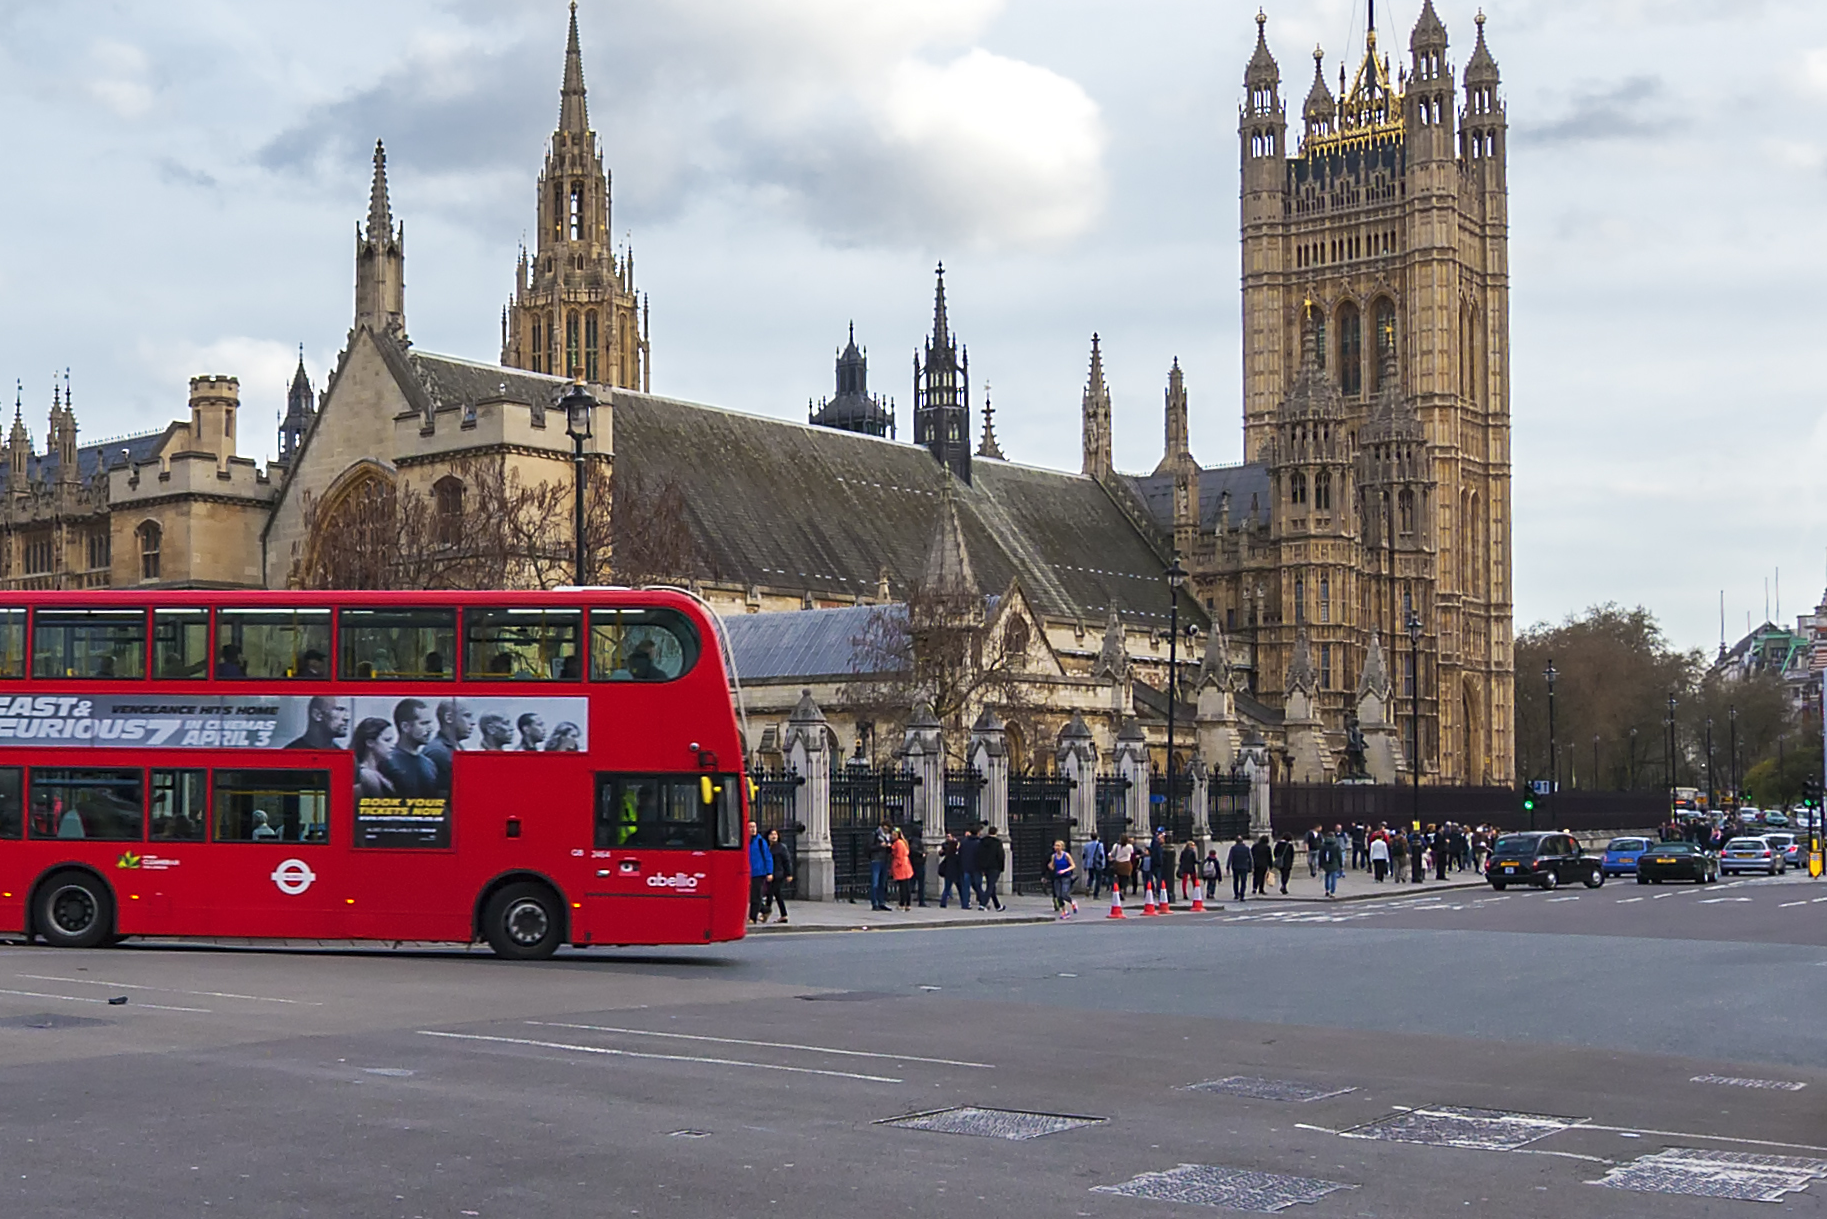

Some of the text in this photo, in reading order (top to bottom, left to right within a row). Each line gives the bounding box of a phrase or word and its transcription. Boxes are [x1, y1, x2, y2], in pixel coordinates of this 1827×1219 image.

[112, 705, 279, 716] VENGEANCE HITS HOME
[184, 719, 278, 731] IN CINEMAS
[181, 730, 273, 747] APRIL 3
[359, 798, 446, 806] BOOK YOUR
[358, 807, 444, 815] TICKETS NOW
[647, 871, 698, 887] abellio
